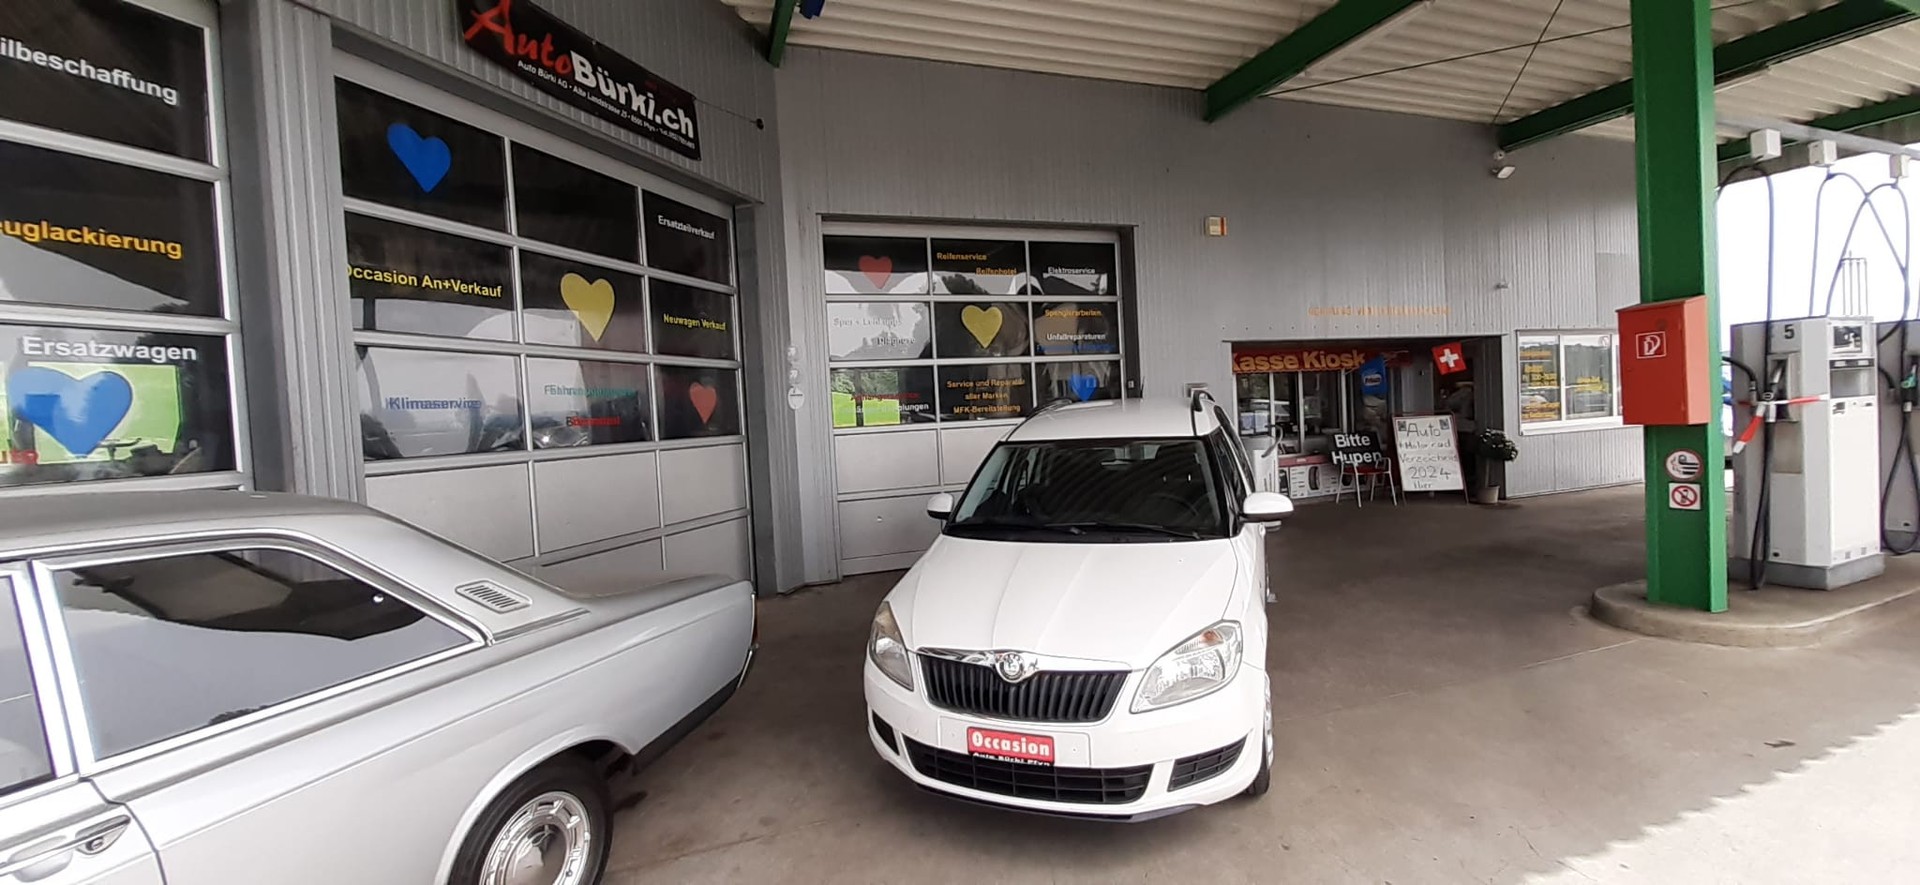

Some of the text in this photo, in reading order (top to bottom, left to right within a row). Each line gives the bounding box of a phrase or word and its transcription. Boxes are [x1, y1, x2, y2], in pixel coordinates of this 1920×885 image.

[0, 37, 179, 106] ilbeschaffung
[517, 60, 537, 74] Auto
[537, 68, 557, 84] Bürki
[557, 78, 568, 89] AG
[657, 214, 716, 240] Ersatzteilverkauf
[936, 252, 988, 261] Reifenservice
[1047, 266, 1096, 275] Elektroservice
[421, 274, 503, 298] An+Verkauf
[663, 313, 727, 331] Neuwagen Verkauf
[1046, 332, 1107, 342] Unfallreparaturen
[1784, 324, 1795, 340] 5
[22, 336, 197, 363] Ersatzwagen
[1302, 349, 1365, 370] Kiosk
[946, 380, 974, 389] Service
[975, 379, 990, 388] und
[386, 396, 482, 410] Klimaservice
[982, 391, 1010, 400] Marken
[1406, 422, 1441, 437] Auto
[1334, 432, 1372, 449] Bitte
[1331, 450, 1382, 468] Hupen
[1407, 465, 1452, 480] 2024
[971, 731, 1050, 757] Occasion
